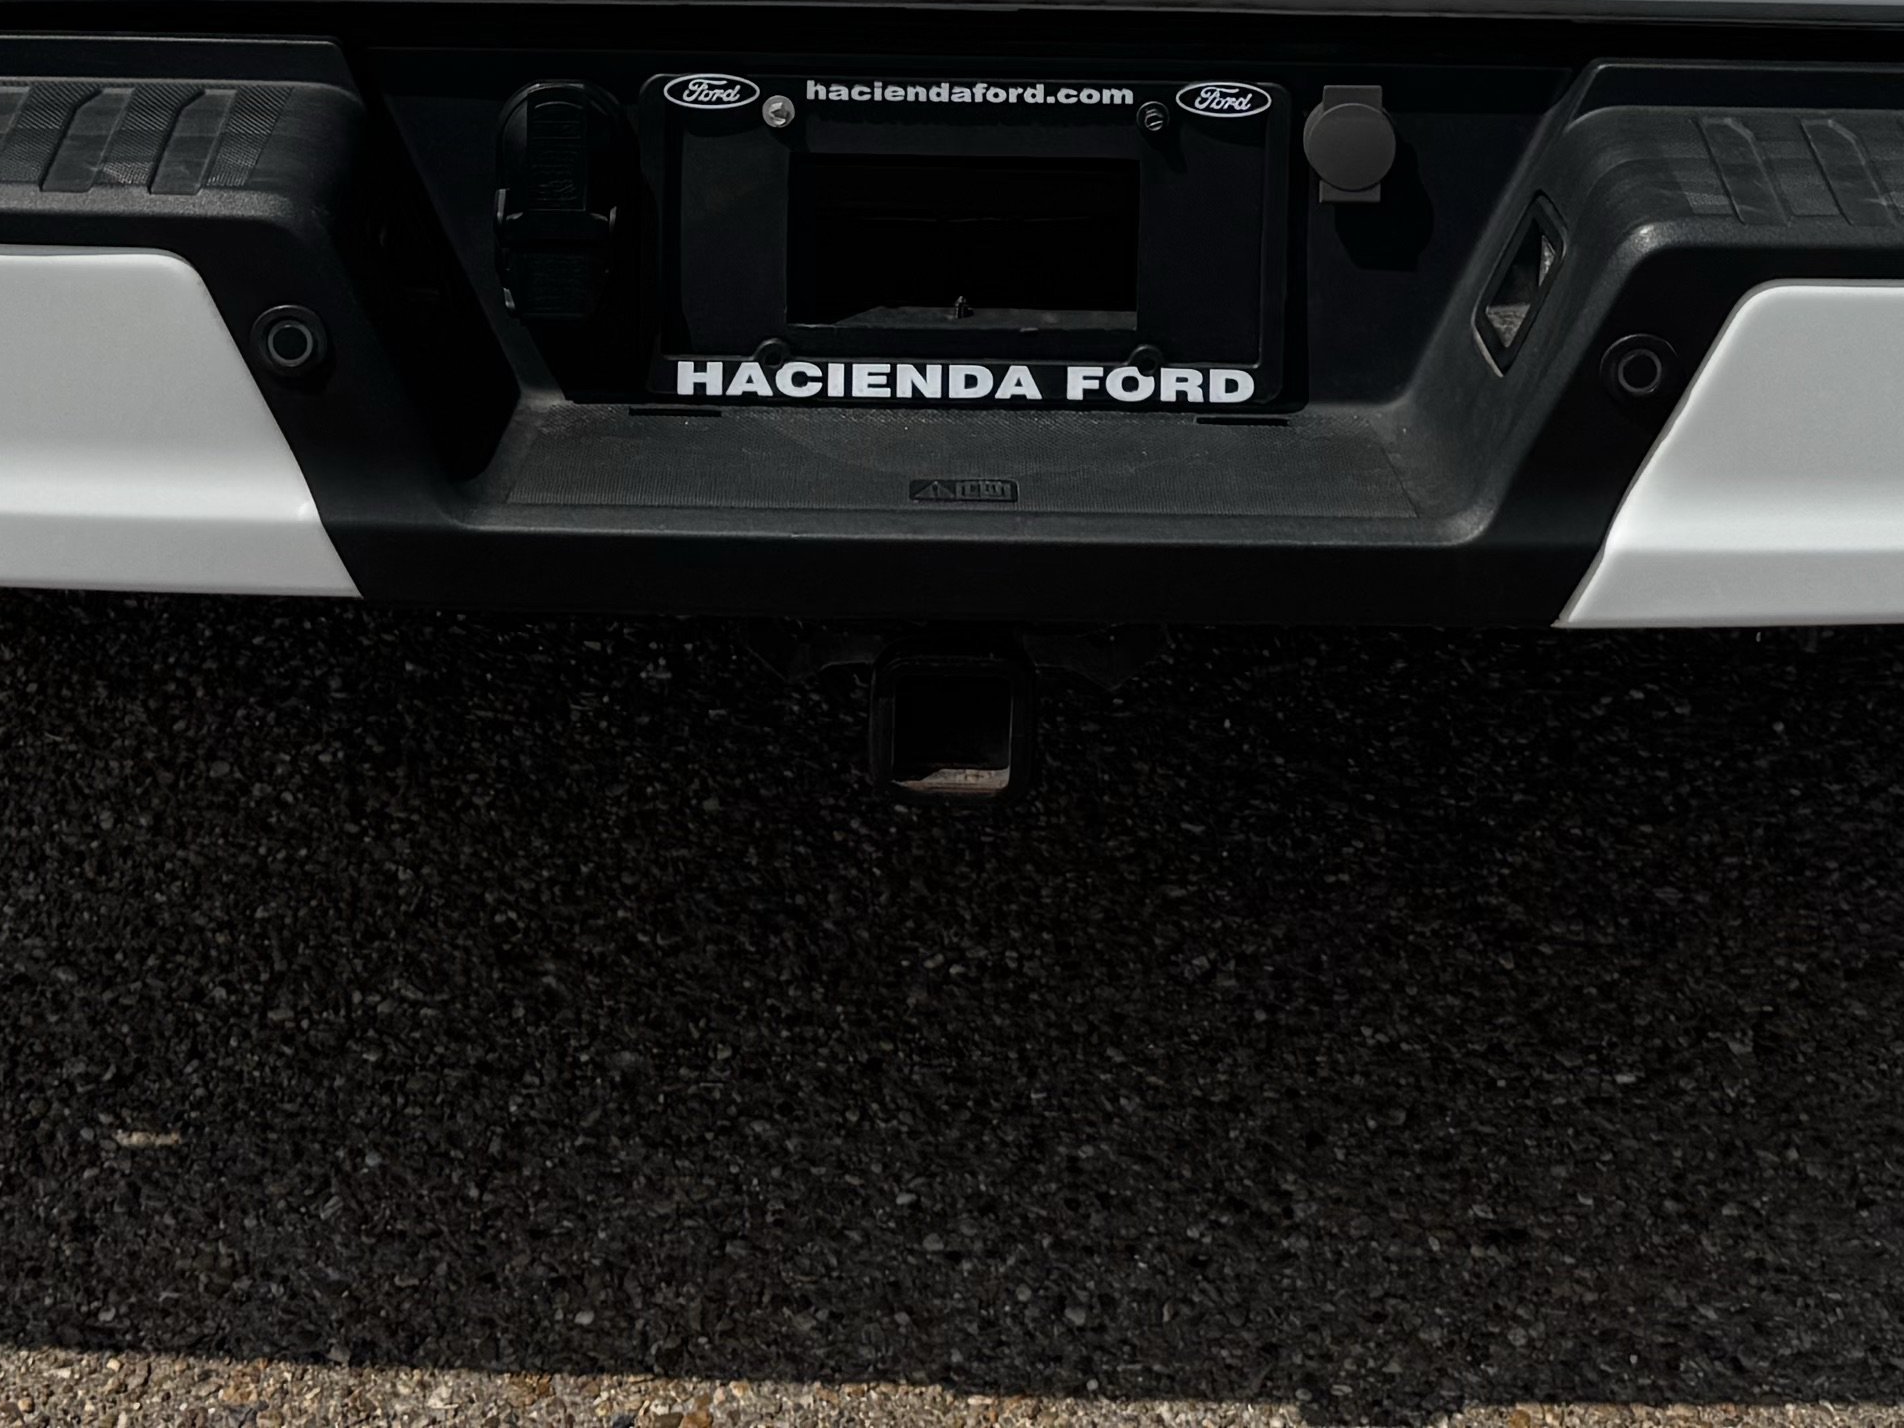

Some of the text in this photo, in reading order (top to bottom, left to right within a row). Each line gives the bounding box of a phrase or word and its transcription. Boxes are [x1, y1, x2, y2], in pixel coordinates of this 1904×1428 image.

[682, 78, 741, 102] Ford
[806, 79, 1134, 105] haciendaford.com
[1194, 86, 1253, 111] Ford
[676, 360, 1256, 404] HACIENDA FORD
